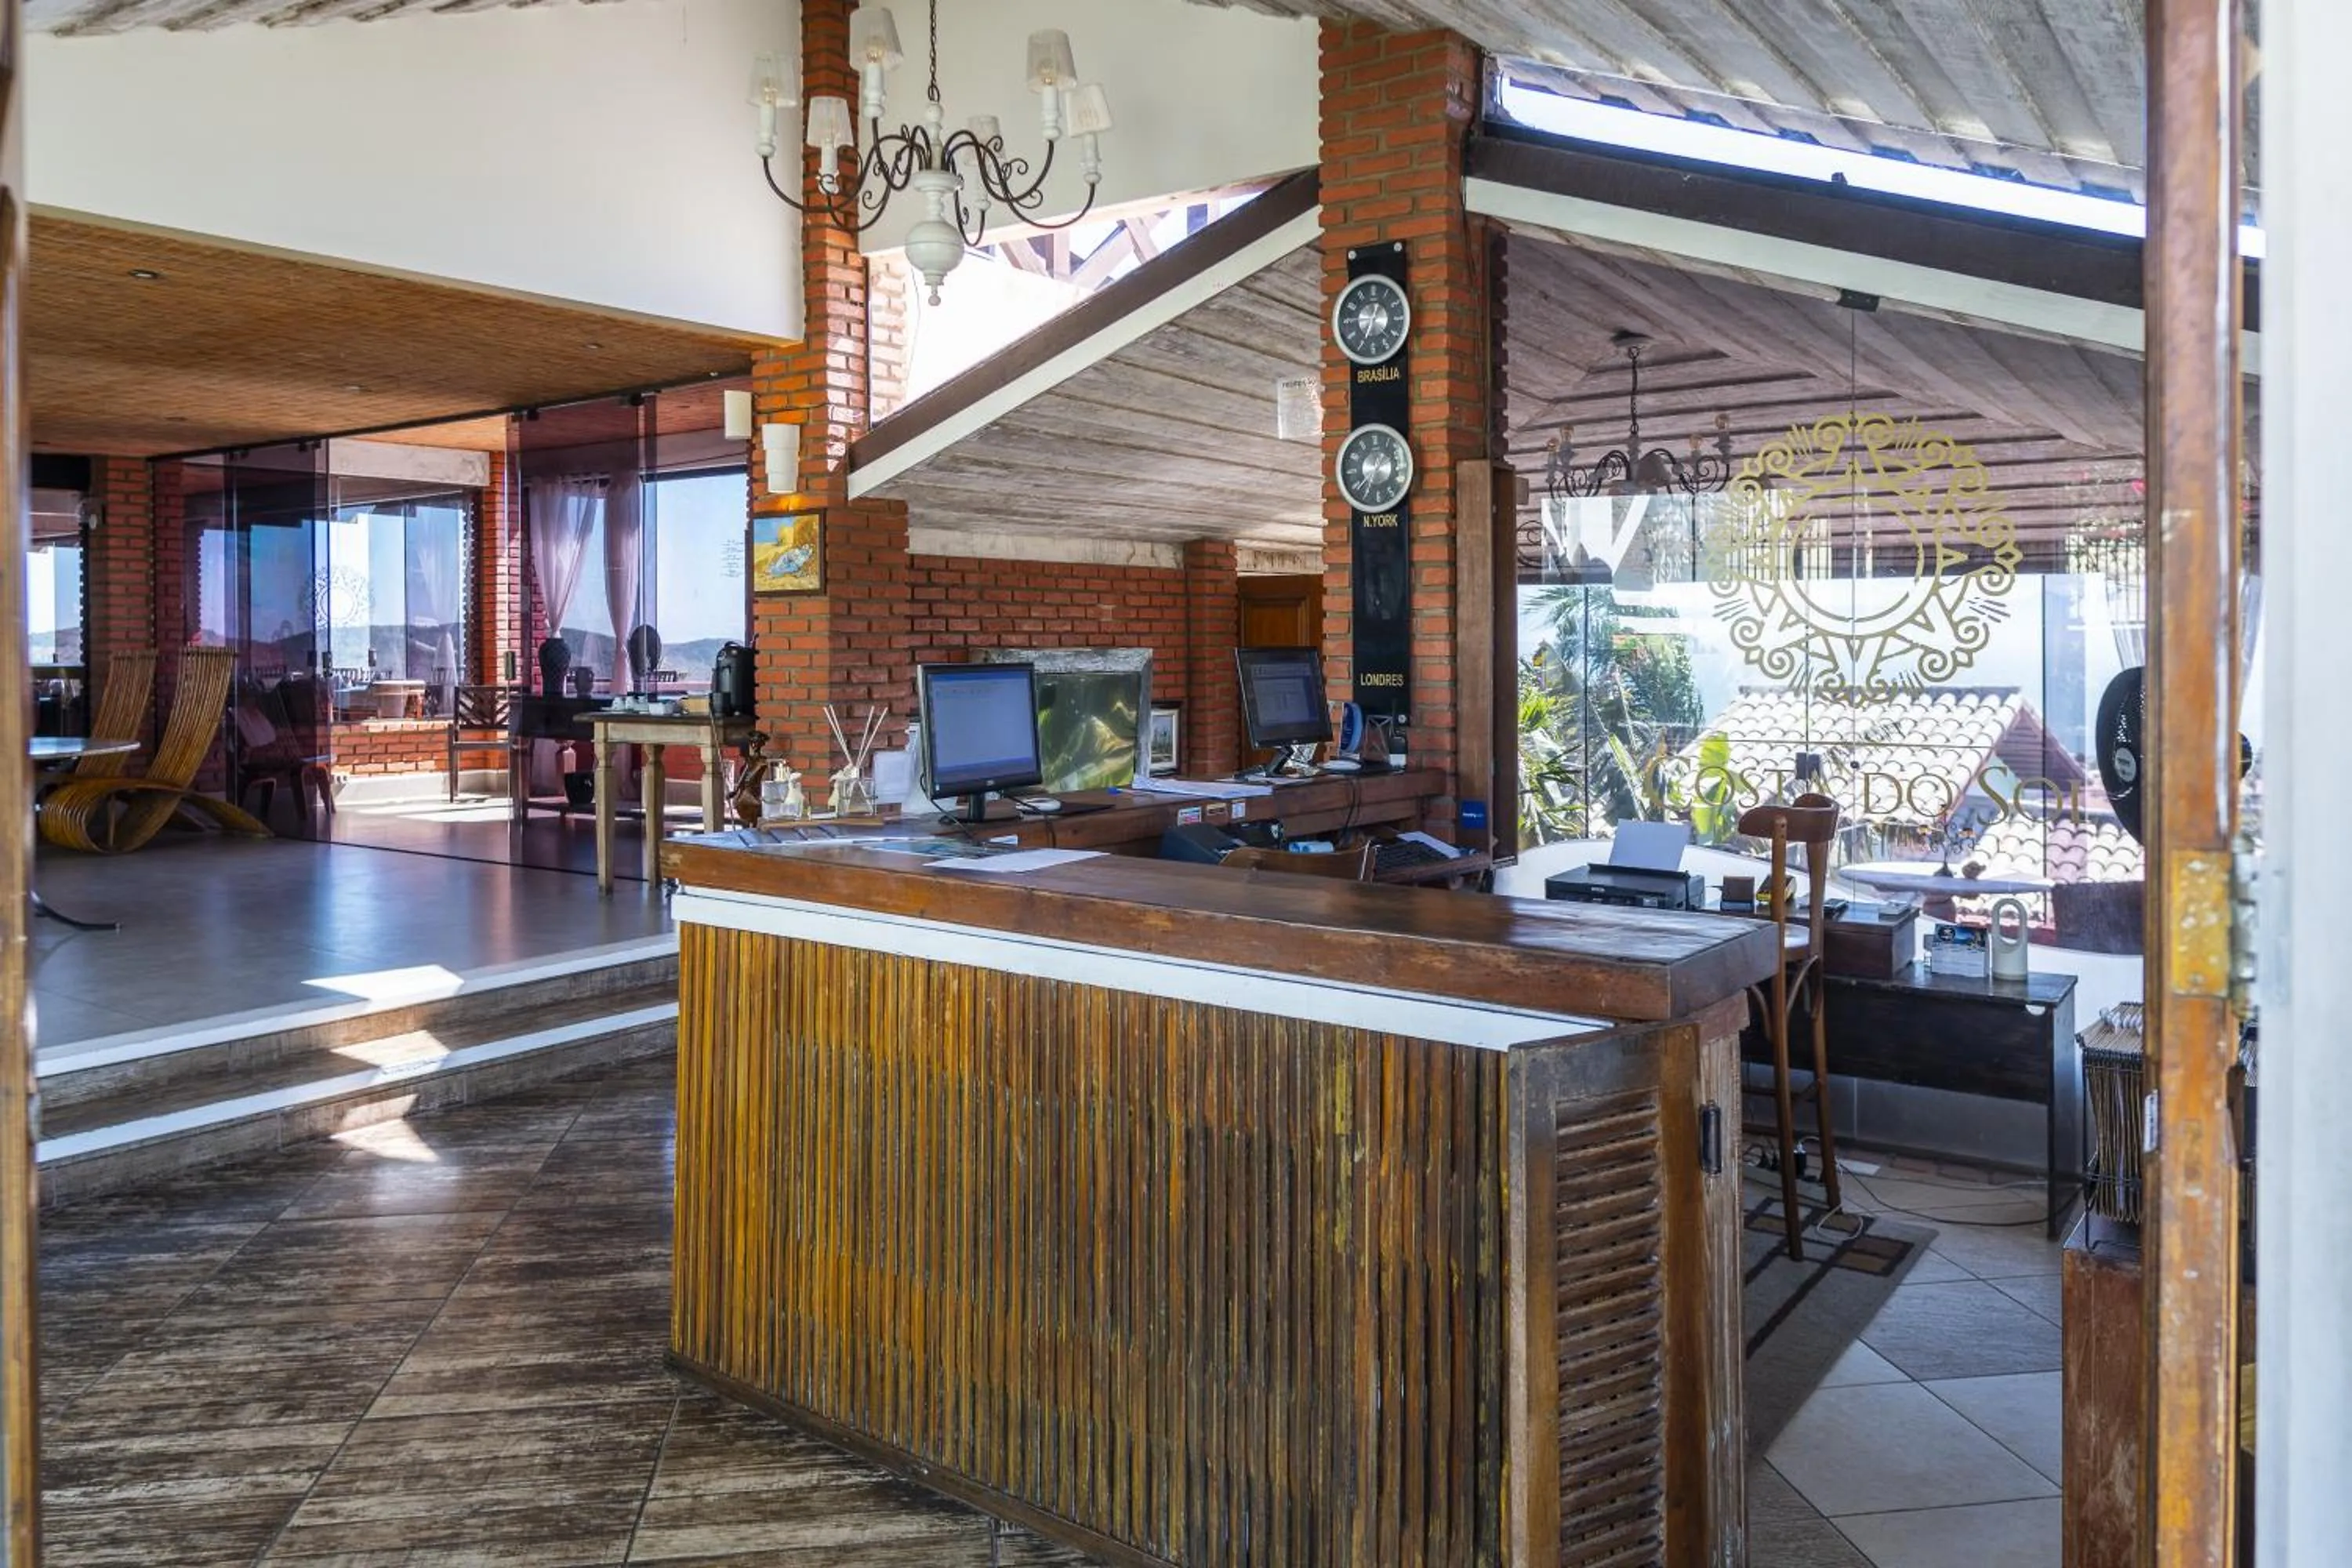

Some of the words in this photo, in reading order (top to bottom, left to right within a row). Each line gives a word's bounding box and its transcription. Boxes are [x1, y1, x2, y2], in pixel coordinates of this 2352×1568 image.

[1363, 514, 1398, 528] N.YORK
[1360, 673, 1404, 687] LONDRES
[1863, 771, 1955, 818] DO
